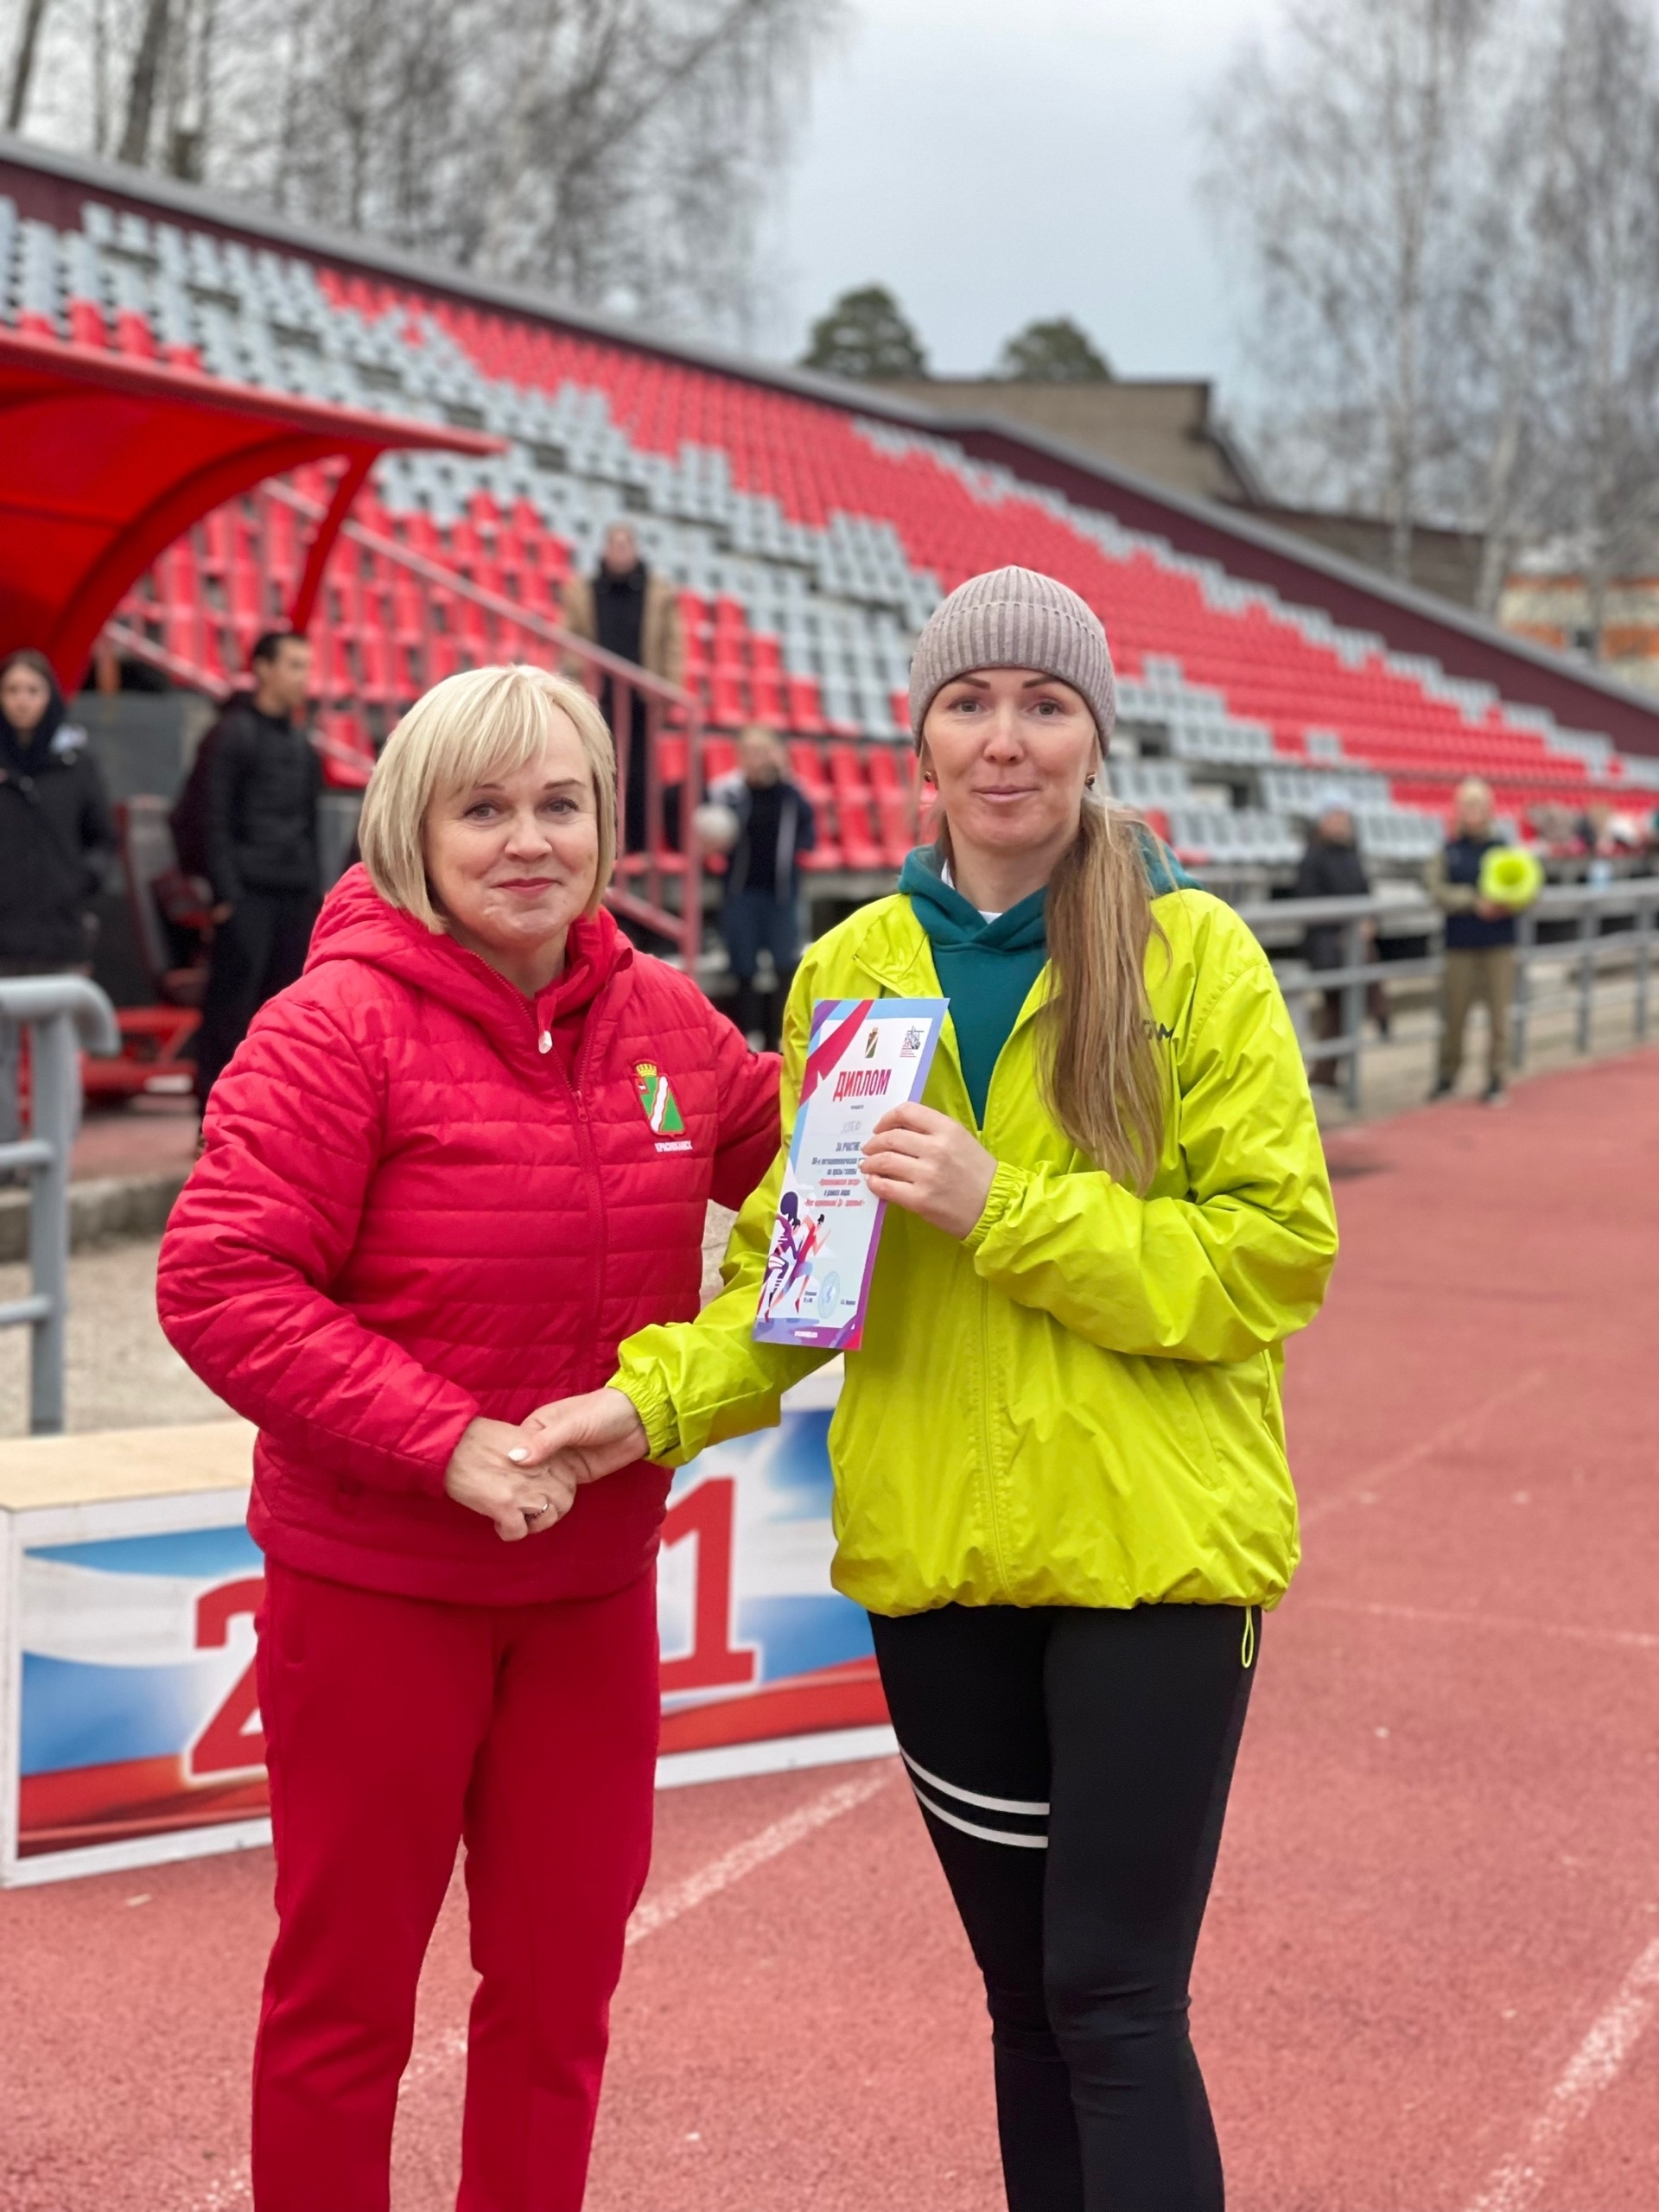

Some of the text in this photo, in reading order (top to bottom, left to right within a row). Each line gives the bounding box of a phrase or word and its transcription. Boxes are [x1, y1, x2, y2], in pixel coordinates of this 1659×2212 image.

[832, 1069, 892, 1102] ДИПЛОМ
[192, 1577, 268, 1775] 2
[660, 1477, 755, 1694] 1
